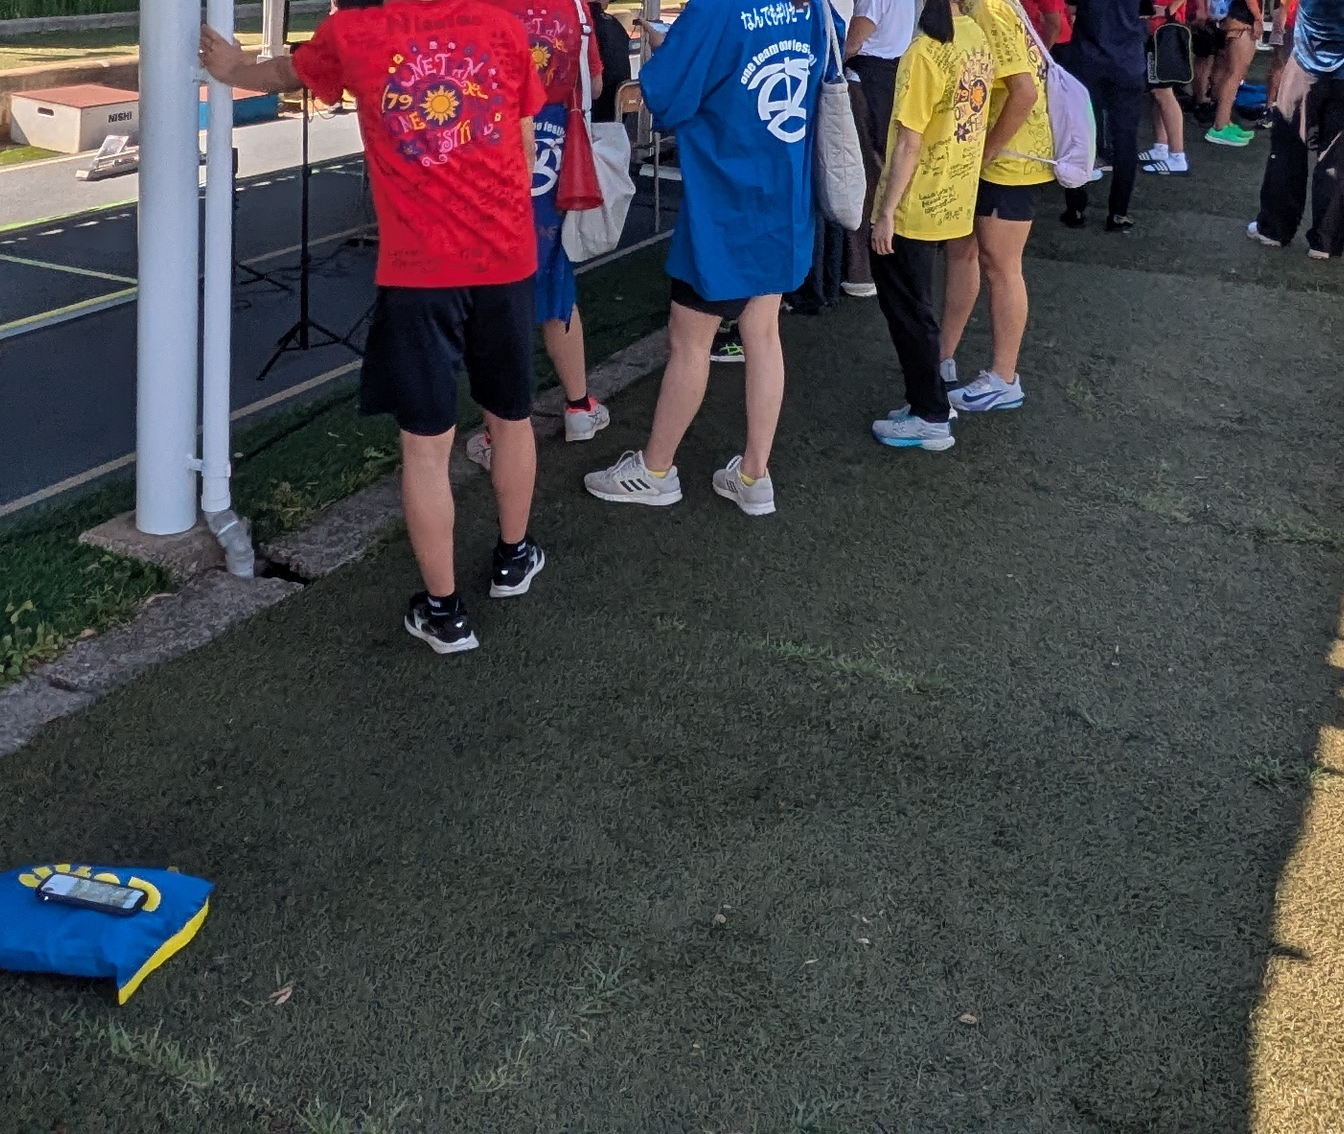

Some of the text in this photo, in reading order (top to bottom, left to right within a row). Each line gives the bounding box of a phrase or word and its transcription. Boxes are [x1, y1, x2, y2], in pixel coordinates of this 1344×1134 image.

[740, 62, 757, 85] one
[752, 43, 780, 66] team
[108, 110, 133, 123] NISHI
